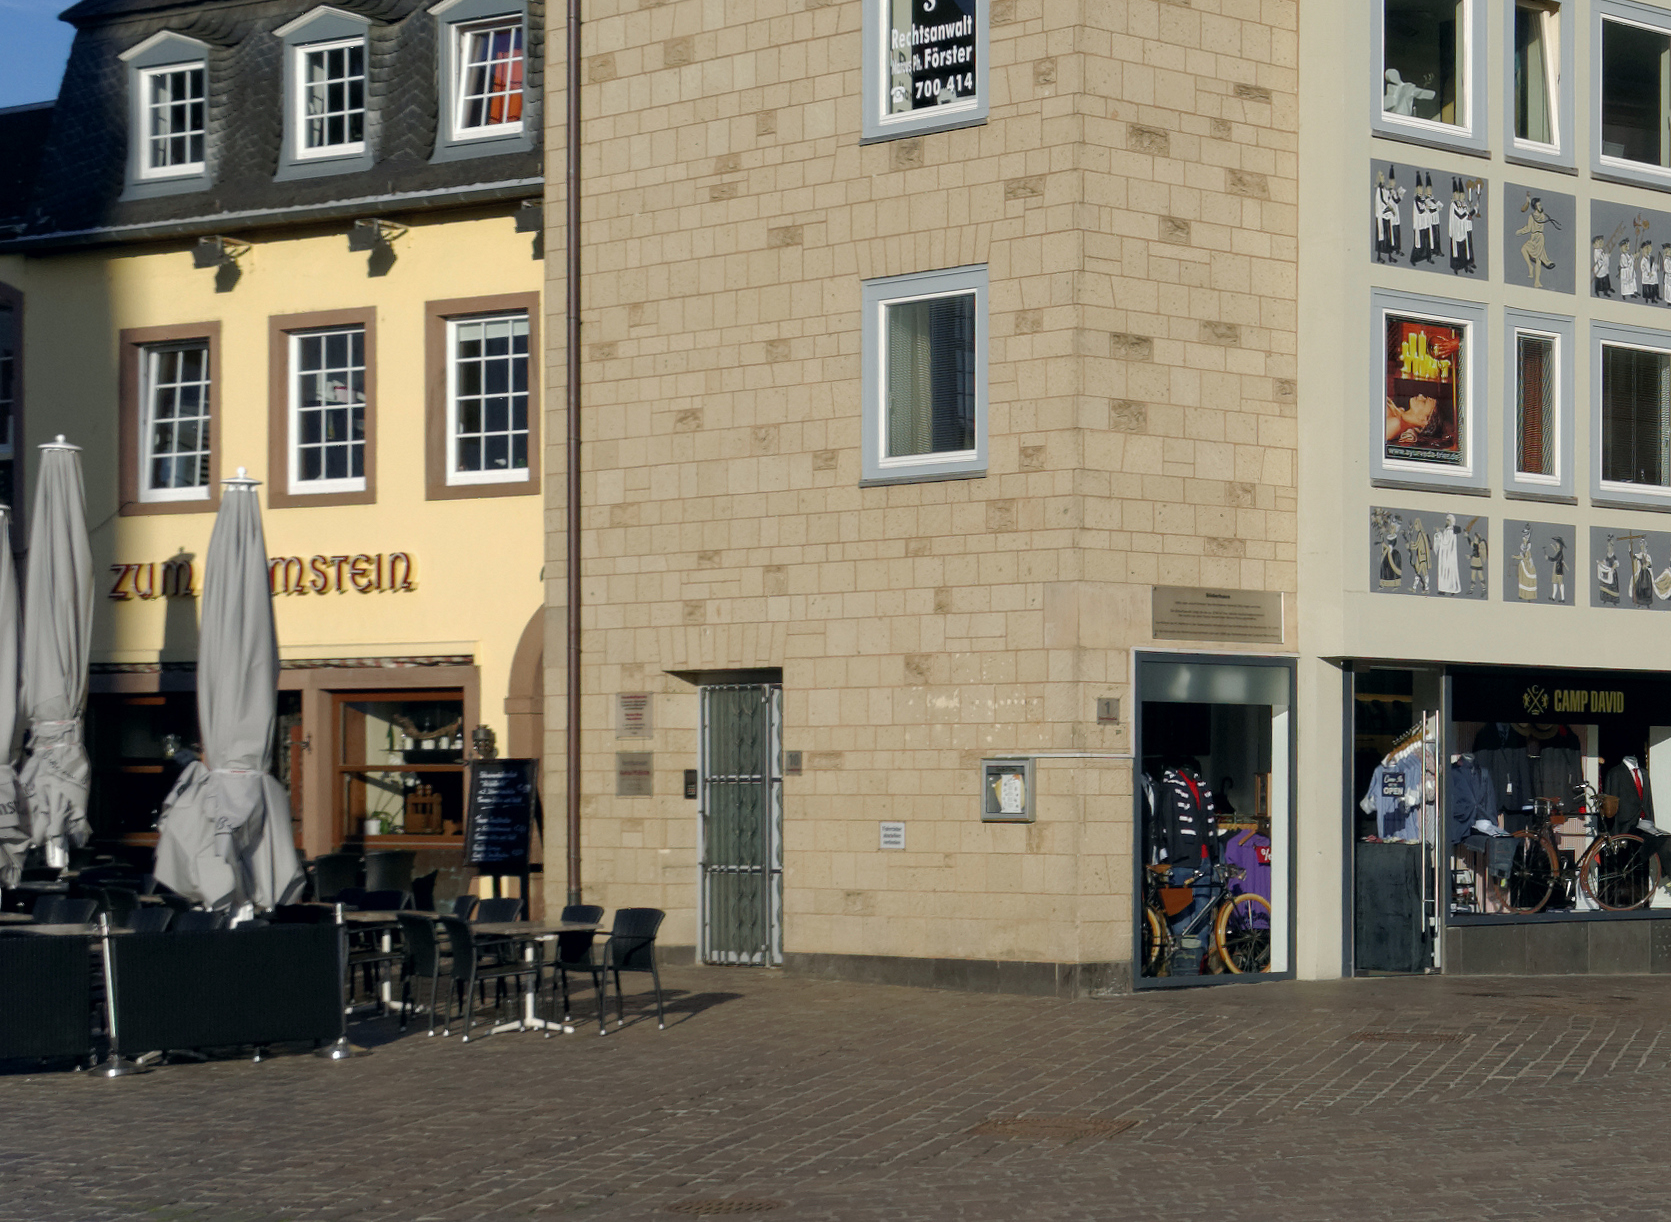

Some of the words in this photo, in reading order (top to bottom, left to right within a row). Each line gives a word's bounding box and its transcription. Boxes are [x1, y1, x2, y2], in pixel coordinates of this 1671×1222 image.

[891, 15, 973, 49] Rechtsanwalt
[924, 44, 973, 69] Förster
[915, 78, 941, 99] 700
[946, 72, 973, 93] 414
[108, 559, 200, 601] ZUM
[268, 551, 416, 595] MSTEIN
[1554, 689, 1588, 712] CAMP
[1590, 690, 1625, 713] DAVID
[1383, 786, 1403, 795] OPEN
